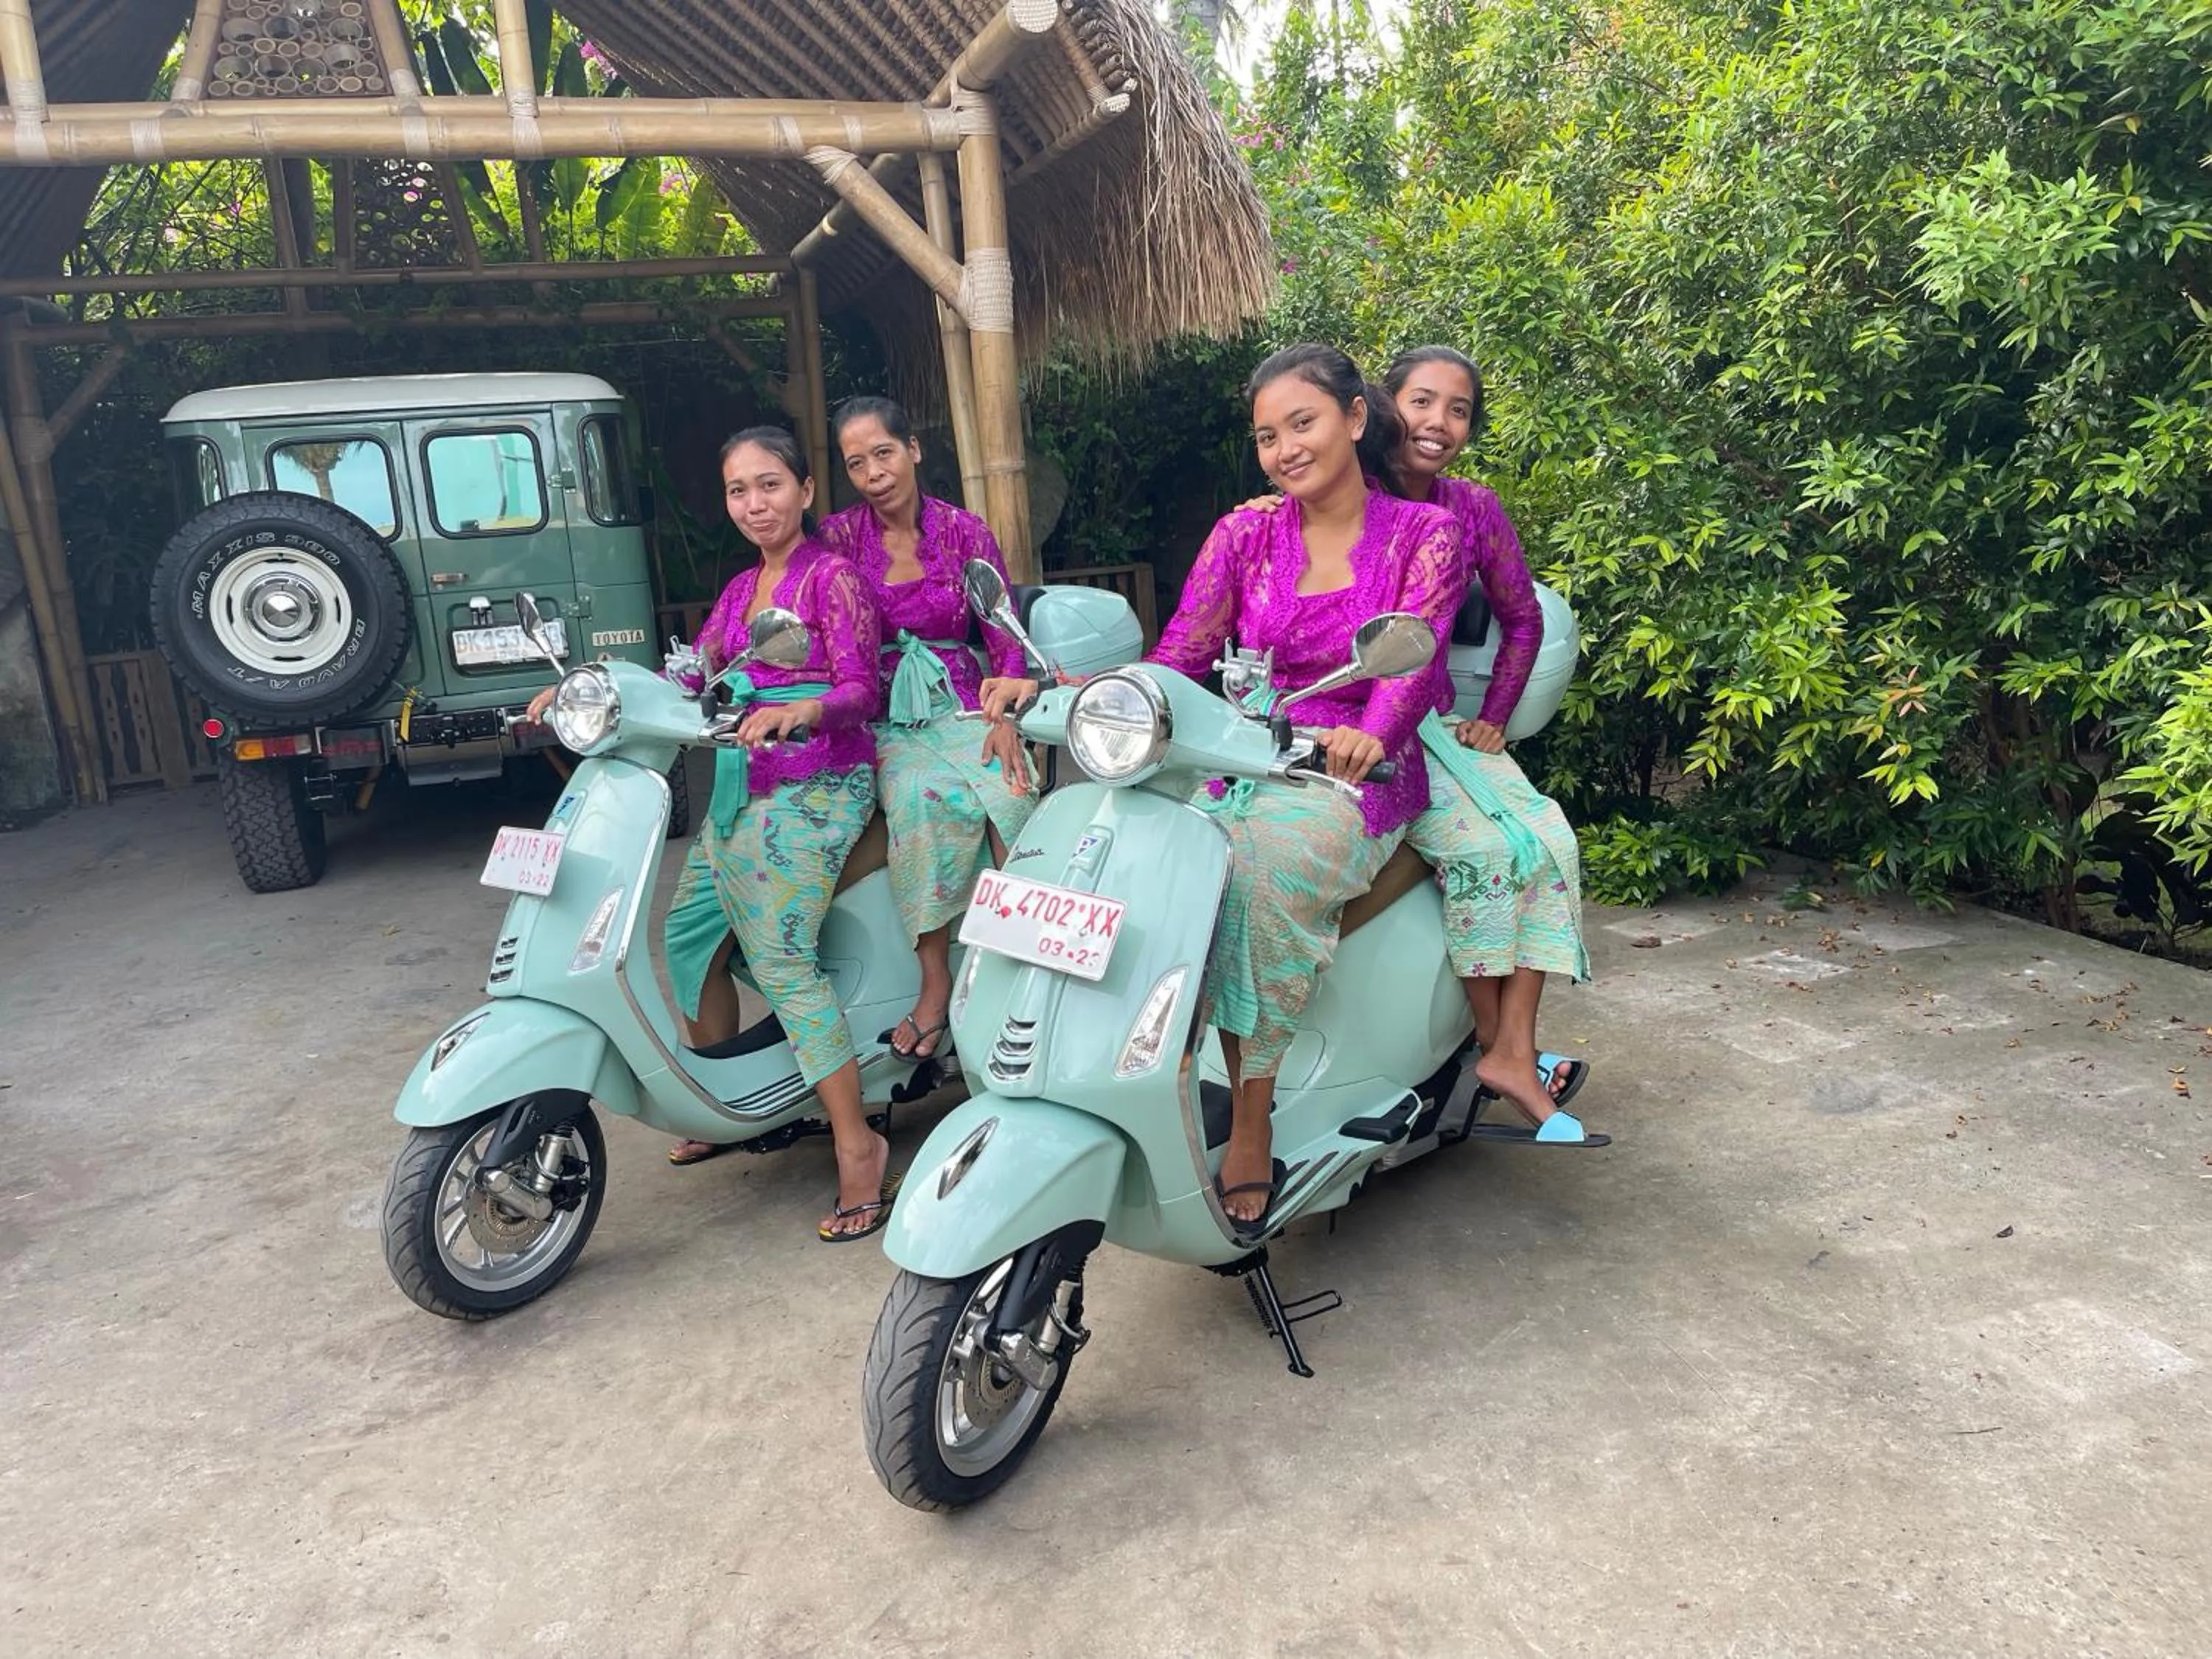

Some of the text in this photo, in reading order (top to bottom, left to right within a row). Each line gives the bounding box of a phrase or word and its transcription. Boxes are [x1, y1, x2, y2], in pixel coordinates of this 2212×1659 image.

[191, 532, 275, 614] MAXXIS
[297, 619, 366, 689] BRAVO
[453, 631, 480, 653] DK
[595, 630, 643, 644] TOYOTA
[493, 832, 561, 864] DK 2115 XX
[975, 877, 1120, 937] DK 4702 XX
